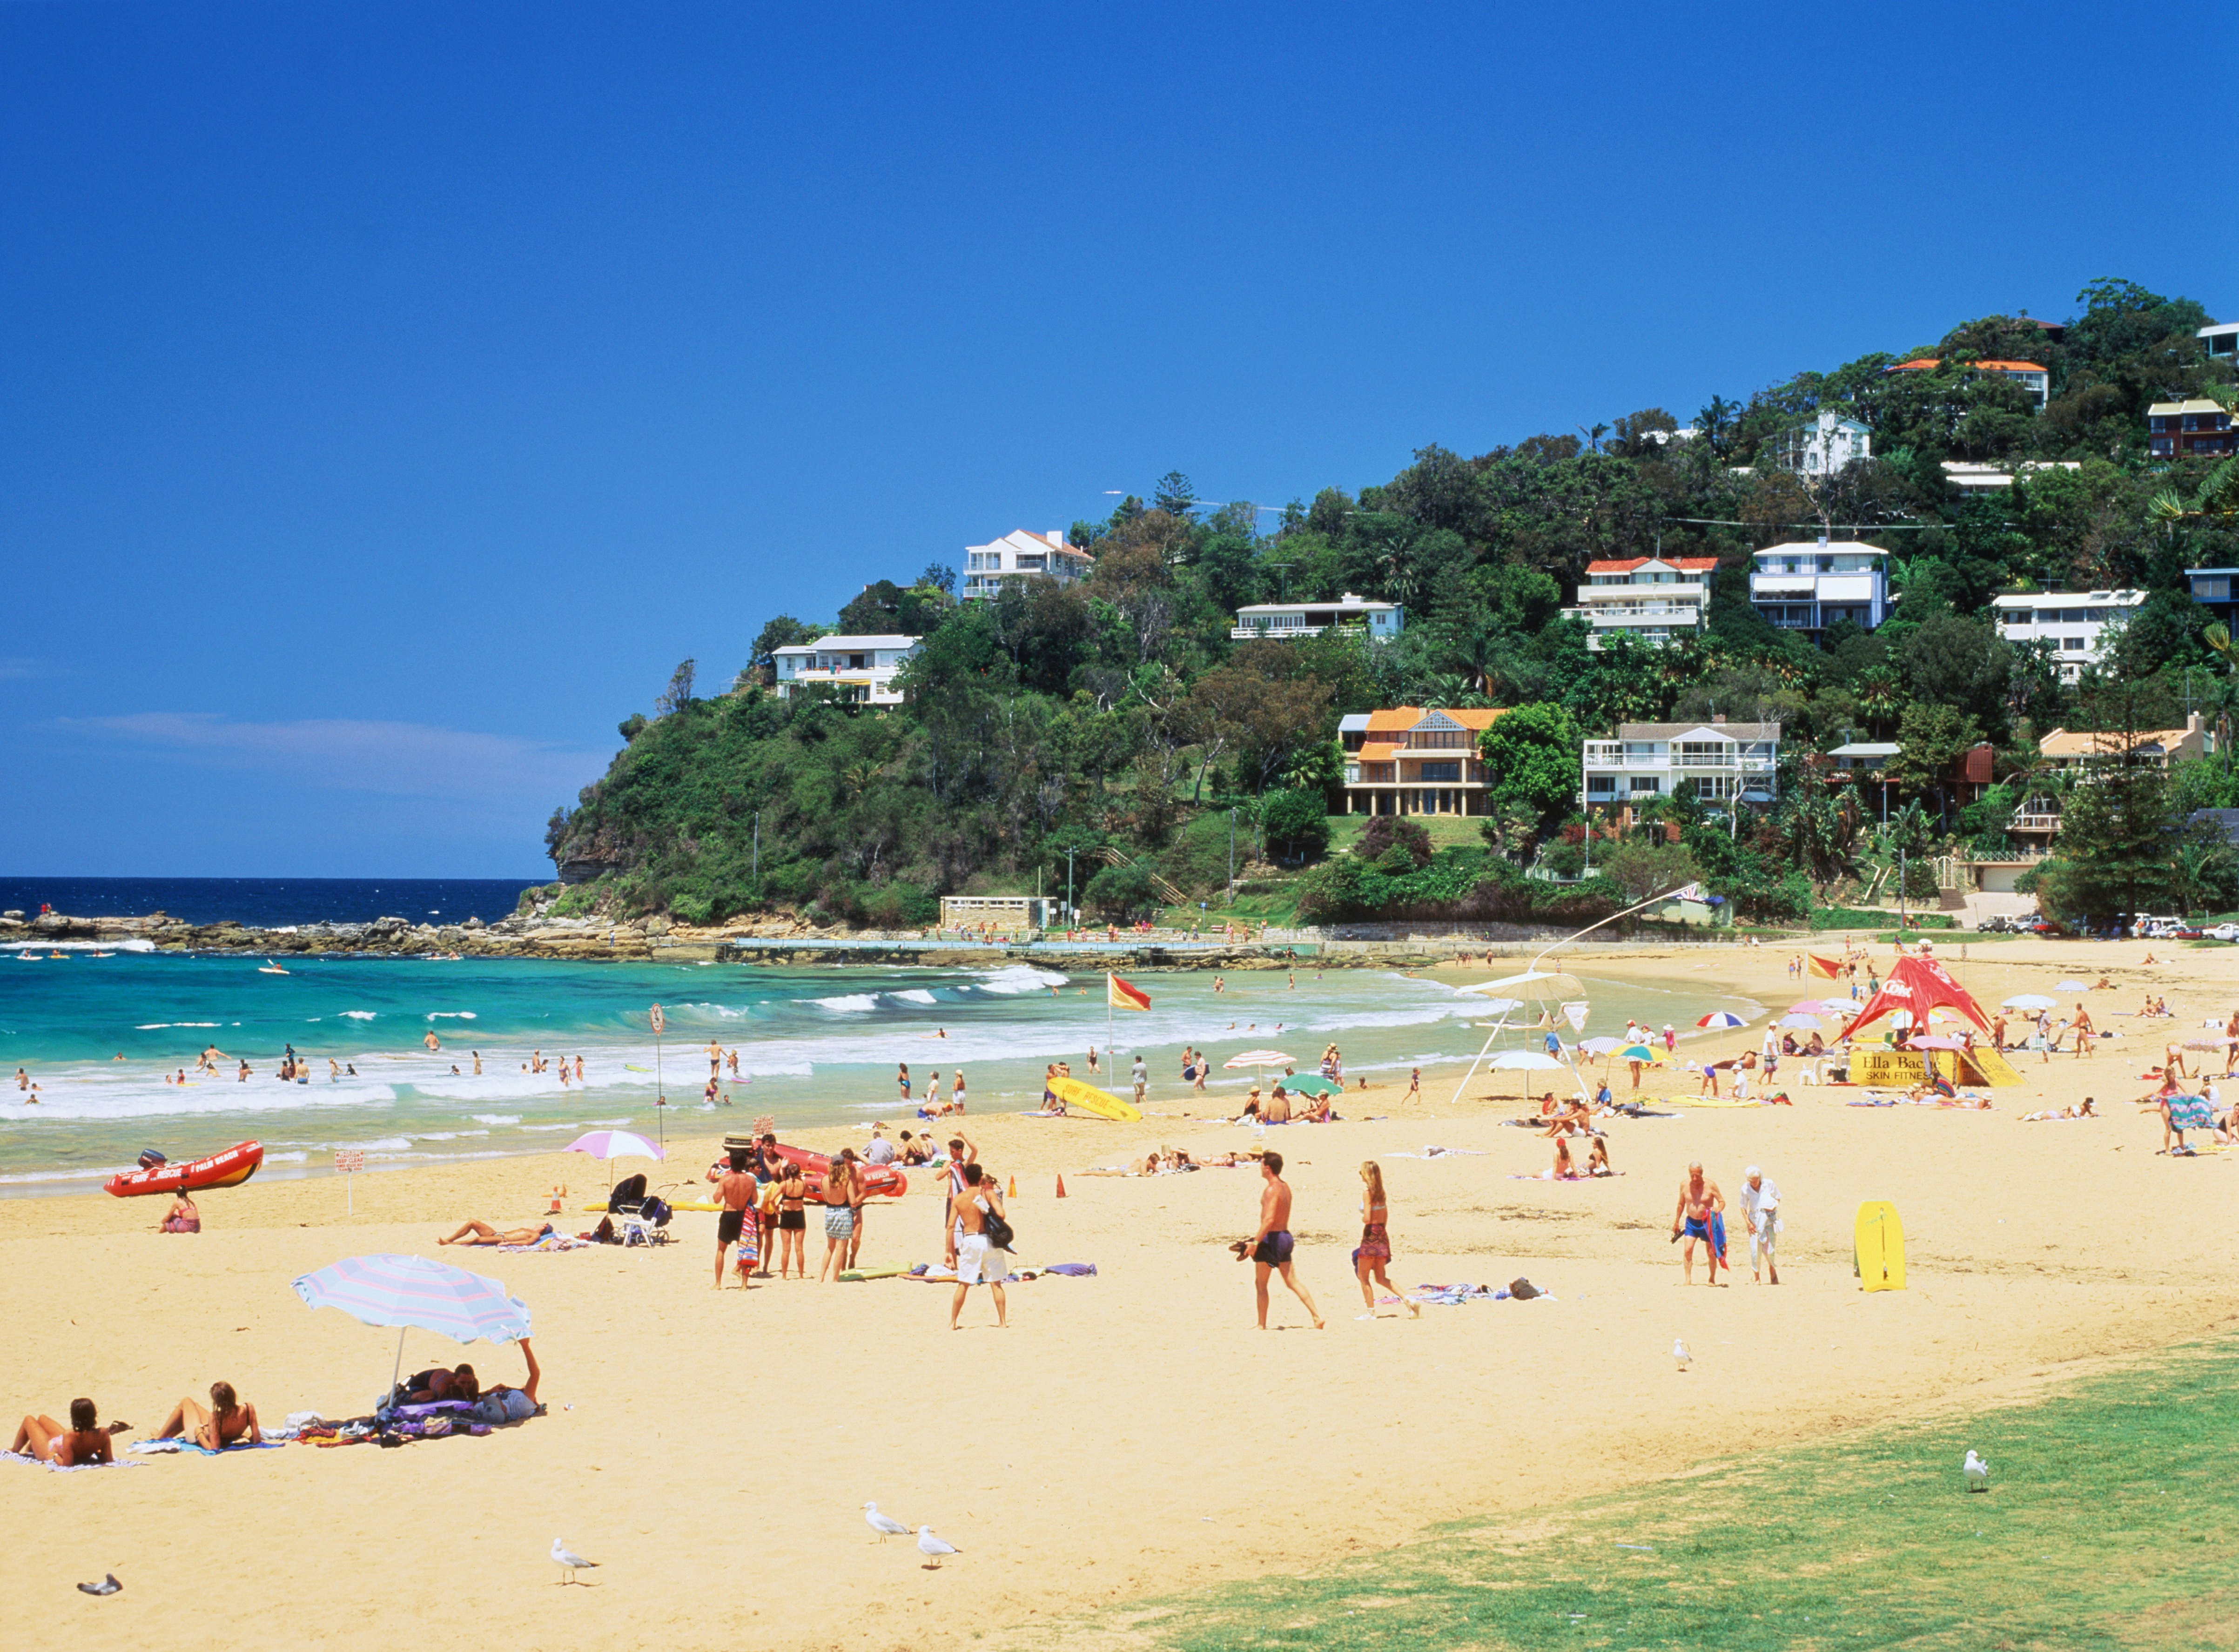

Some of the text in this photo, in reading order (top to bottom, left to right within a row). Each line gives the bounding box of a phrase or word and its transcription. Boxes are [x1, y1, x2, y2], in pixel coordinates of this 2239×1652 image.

[1881, 979, 1913, 998] Coke
[1863, 1056, 1889, 1068] Ella
[1064, 1084, 1110, 1109] SURF RESCUE
[195, 1150, 239, 1172] PALM BEACH
[131, 1168, 182, 1183] SURF RESCUE
